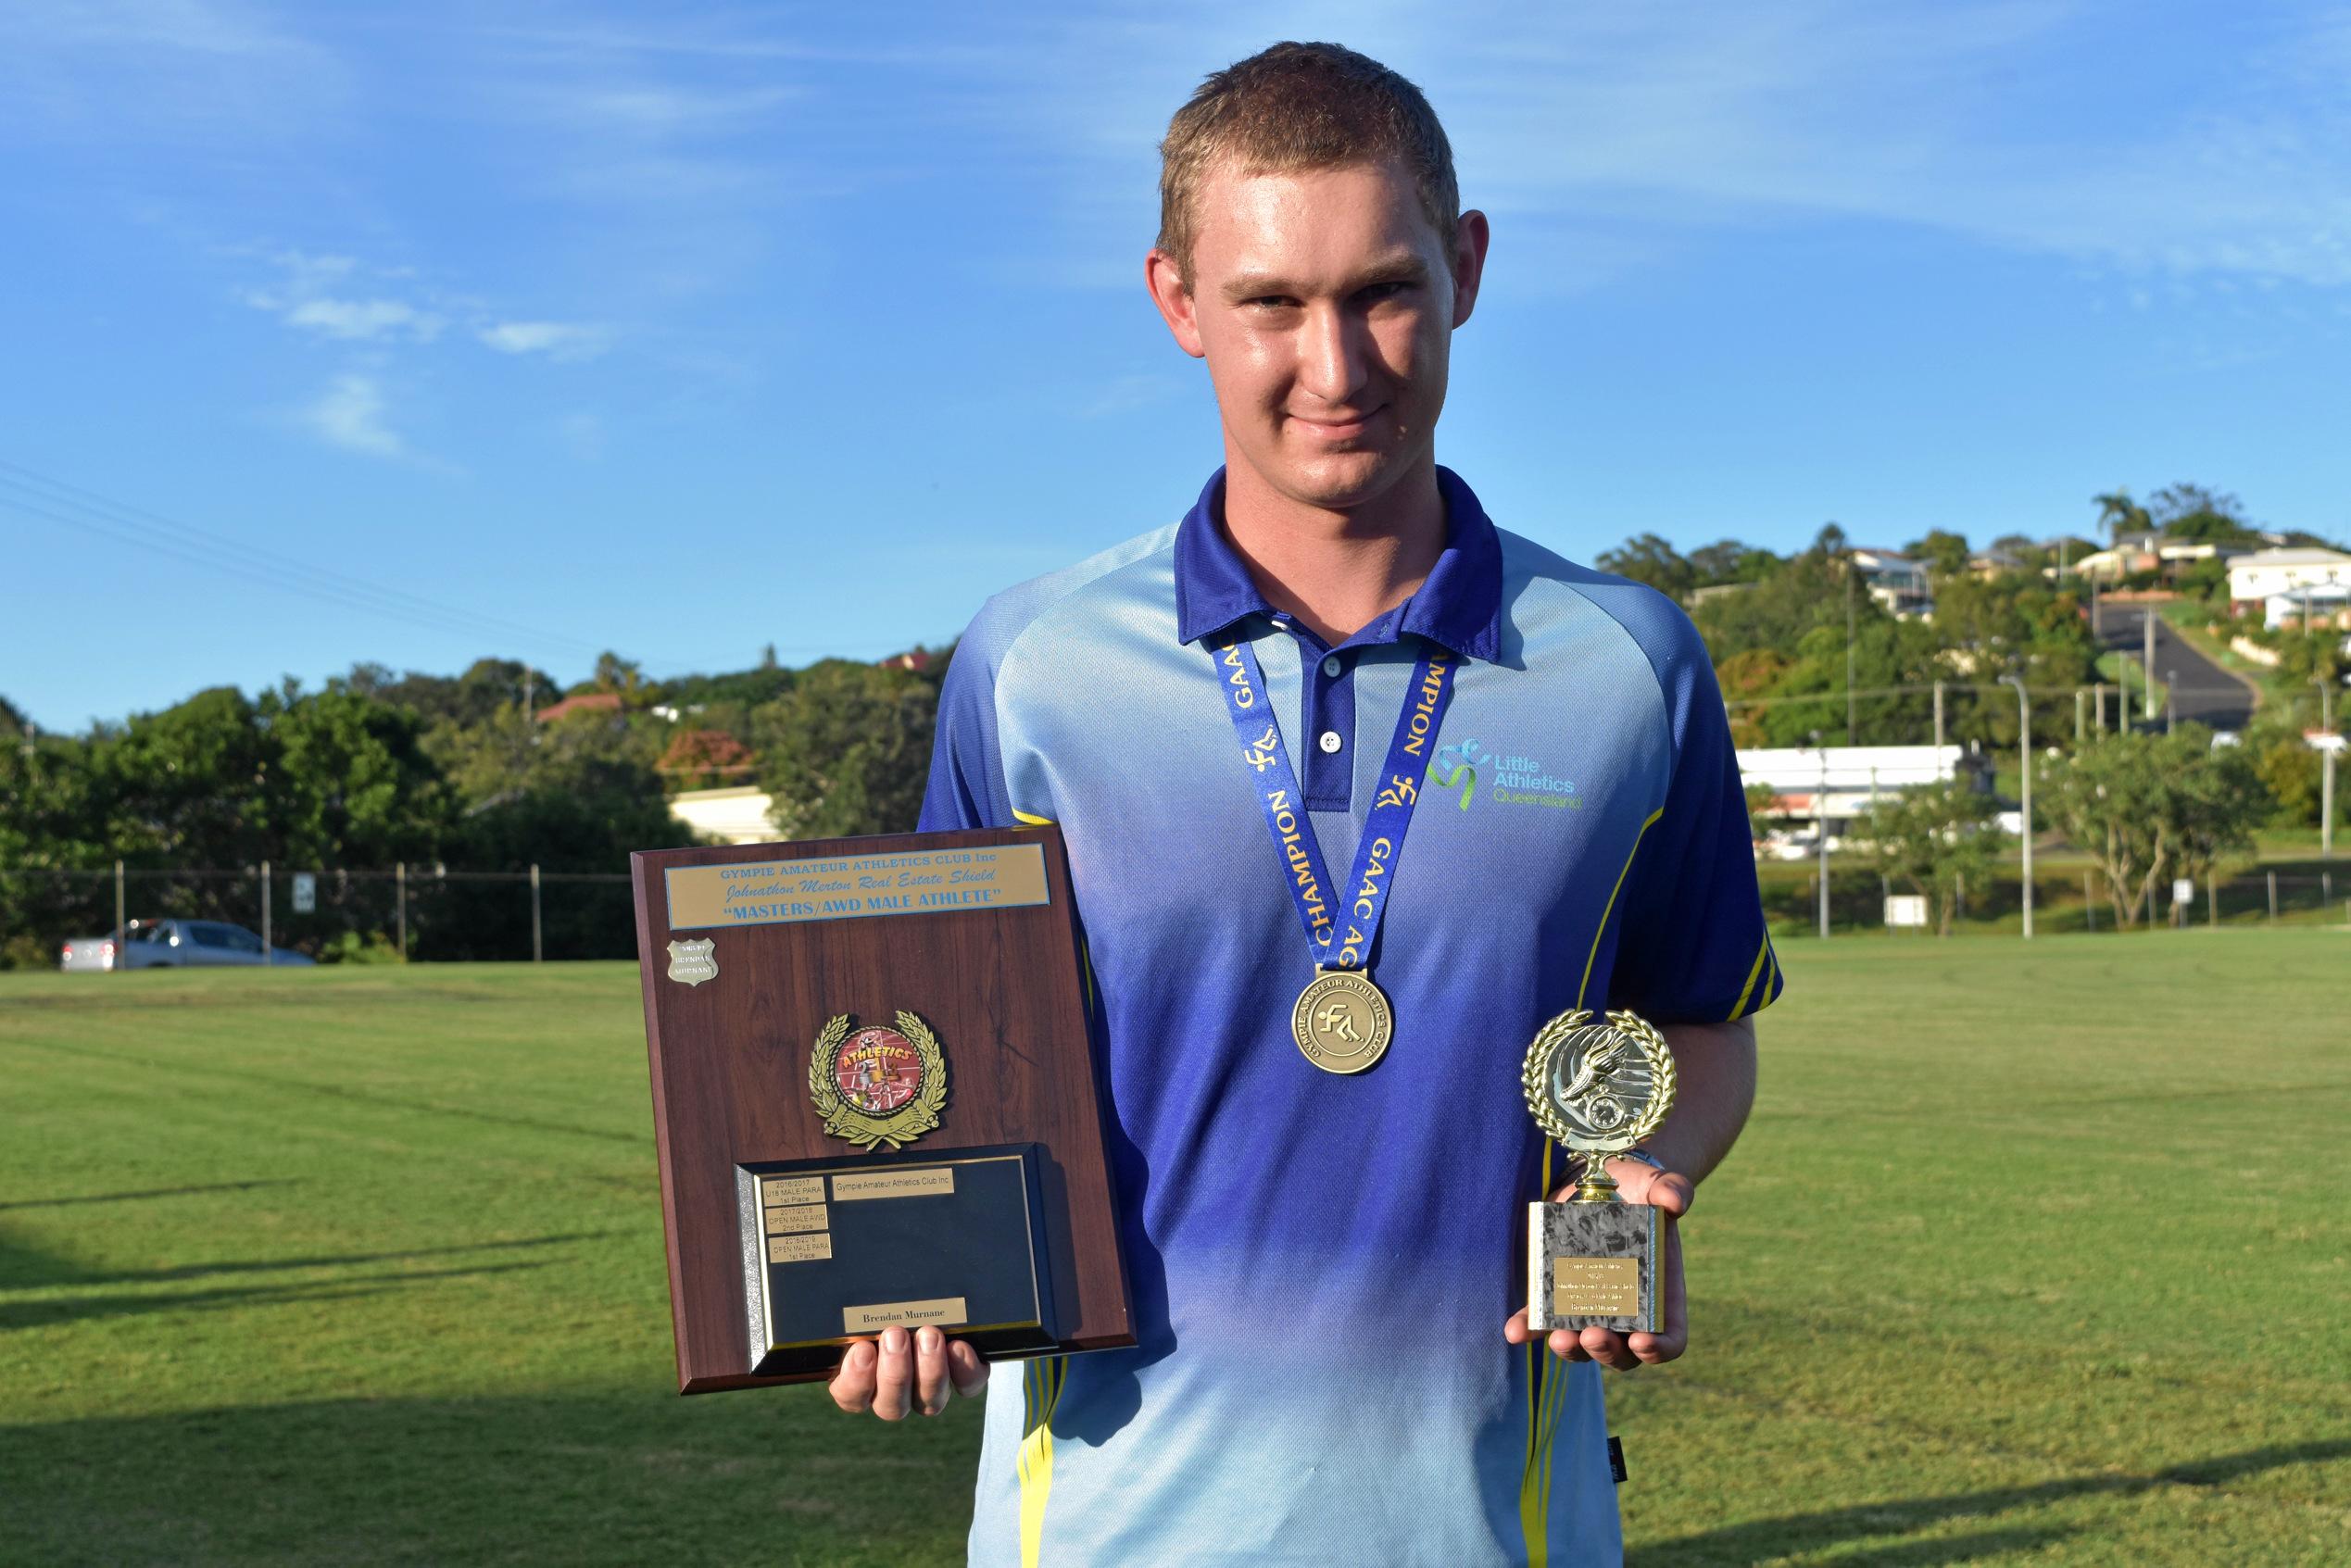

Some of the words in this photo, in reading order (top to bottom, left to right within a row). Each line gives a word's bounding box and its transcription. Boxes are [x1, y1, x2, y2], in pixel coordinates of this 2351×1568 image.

[1494, 755, 1540, 771] Little
[1493, 772, 1576, 793] Athletics
[1493, 788, 1583, 811] Queensland
[721, 867, 775, 879] GYMPIE
[780, 862, 849, 875] AMATEUR
[853, 857, 931, 871] ATHLETICS
[935, 854, 972, 865] CLUB
[976, 853, 997, 862] Inc
[1267, 789, 1334, 947] CHAMPION
[726, 882, 795, 903] Johnathon
[798, 880, 851, 893] Merton
[858, 875, 892, 890] Real
[898, 872, 943, 888] Estate
[949, 868, 996, 884] Shield
[1353, 837, 1391, 920] GAAC
[867, 894, 912, 910] MALE
[1301, 979, 1343, 1014] AMATEUR
[1345, 980, 1386, 1028] ATHLETICS
[1298, 1016, 1321, 1057] GYMPIE
[1364, 1031, 1386, 1058] CLUB
[843, 1047, 912, 1068] ATHLETICS
[836, 1182, 862, 1193] Gympie
[863, 1180, 891, 1189] Amateur
[892, 1178, 920, 1186] Athletics
[921, 1176, 937, 1185] Club
[773, 1246, 792, 1254] OPEN
[793, 1244, 811, 1252] MALE
[811, 1242, 830, 1250] PARA
[862, 1312, 902, 1323] Brendan
[905, 1309, 945, 1320] Murnane
